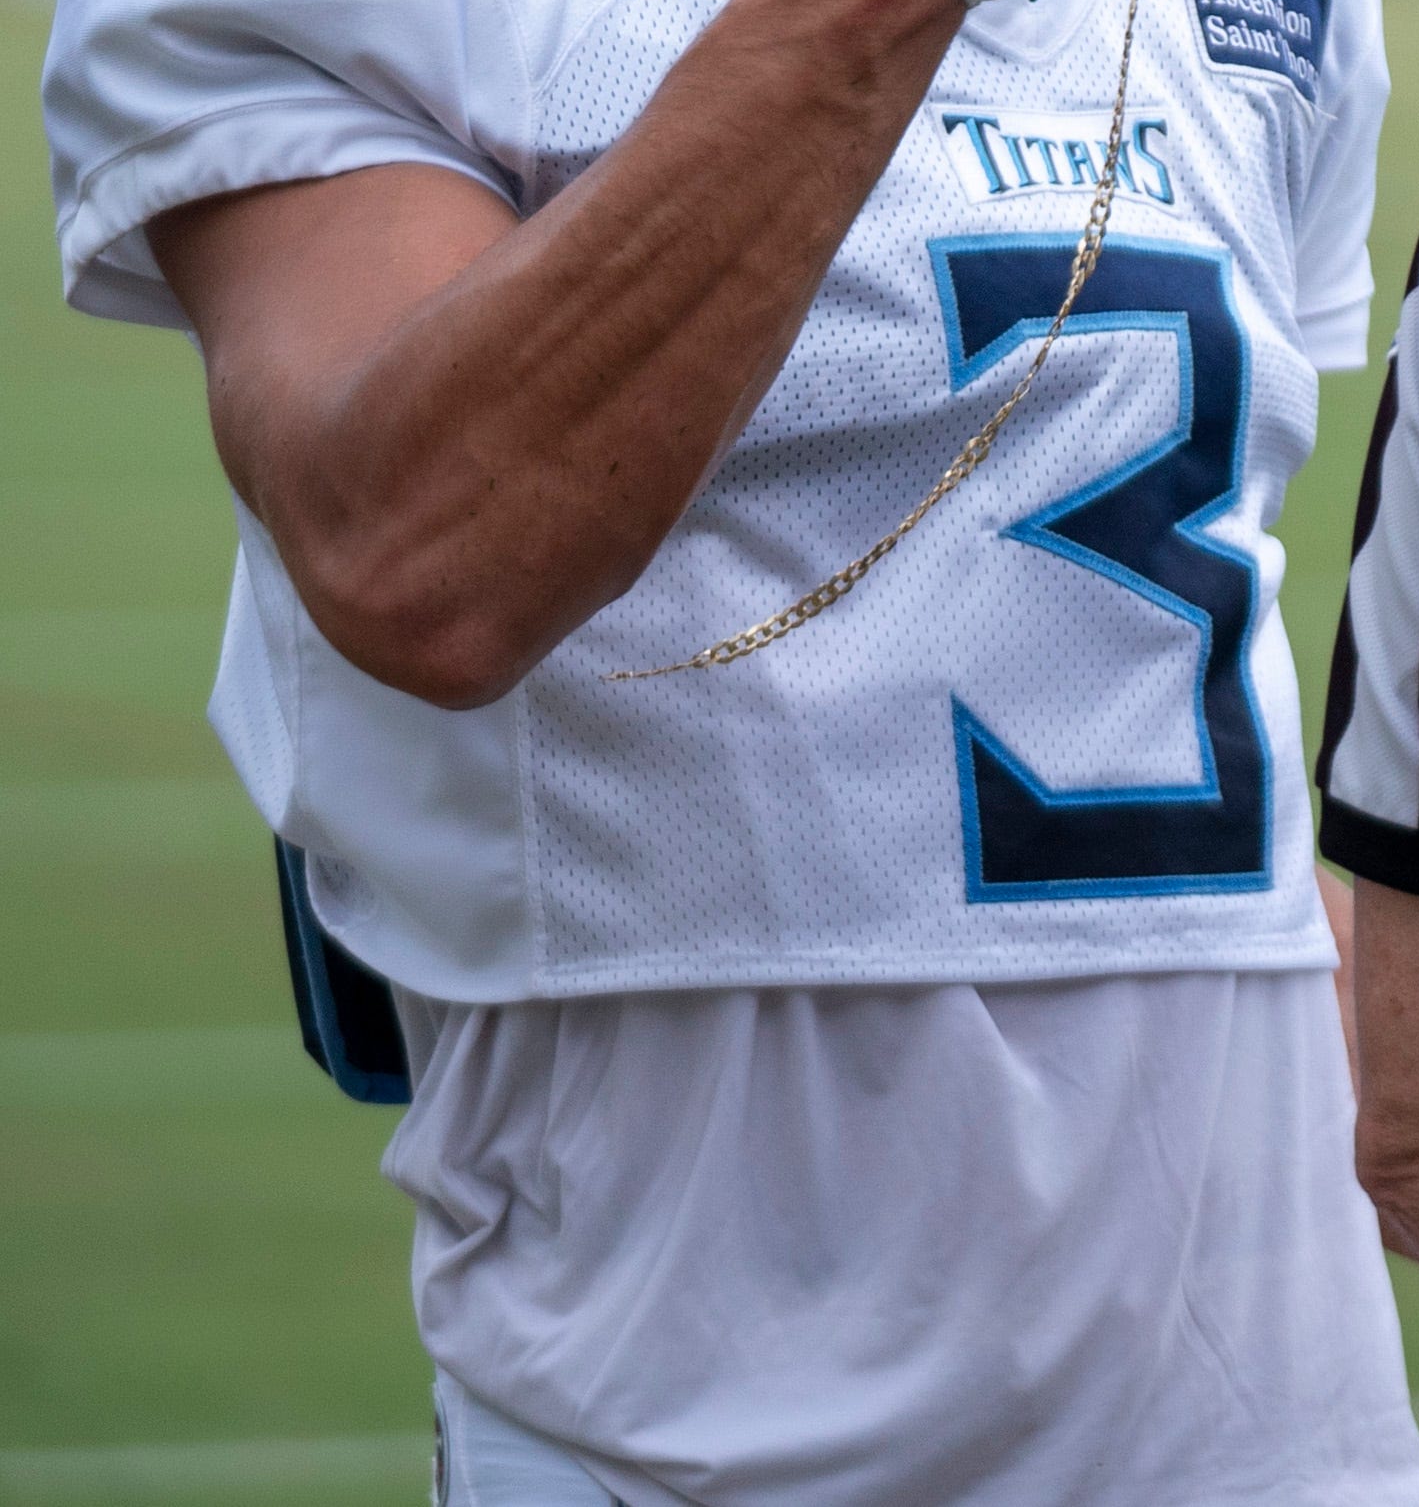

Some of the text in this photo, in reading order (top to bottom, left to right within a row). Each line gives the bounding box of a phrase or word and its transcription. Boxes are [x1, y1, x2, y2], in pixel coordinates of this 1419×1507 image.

[1207, 15, 1280, 58] Saint
[942, 113, 1174, 205] TITANS
[926, 230, 1274, 904] 3
